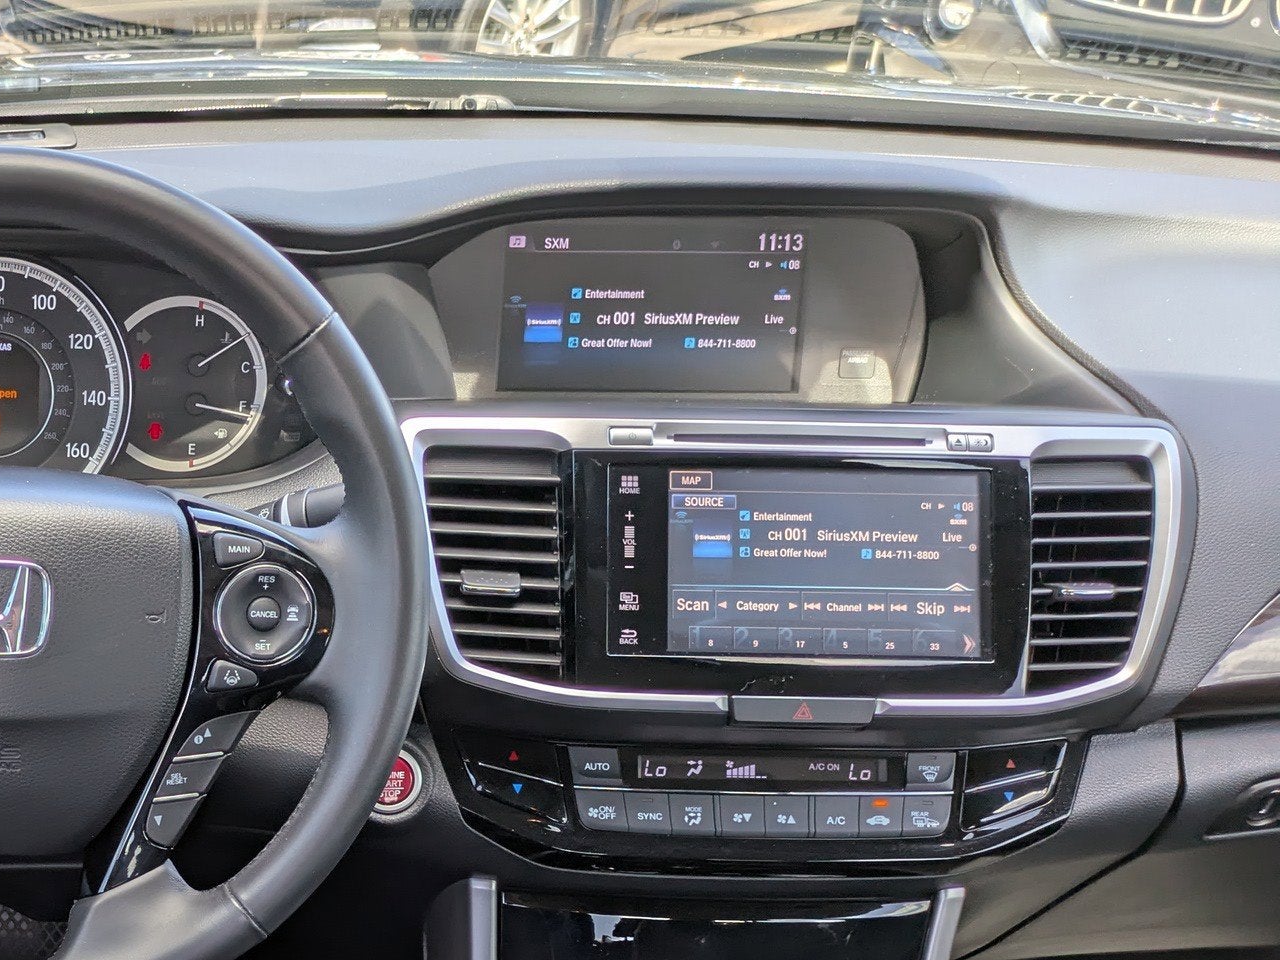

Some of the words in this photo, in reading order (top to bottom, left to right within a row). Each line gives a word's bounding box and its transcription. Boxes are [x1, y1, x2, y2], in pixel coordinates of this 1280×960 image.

[544, 238, 569, 249] SXM
[759, 233, 803, 251] 11:13
[789, 260, 800, 269] 08
[585, 289, 644, 299] Entertainment
[32, 295, 56, 310] 100
[196, 315, 204, 327] H
[597, 315, 610, 325] CH
[614, 312, 635, 325] 001
[645, 313, 692, 325] SiriusXM
[696, 313, 739, 325] Preview
[765, 314, 783, 324] Live
[69, 334, 93, 349] 120
[582, 338, 604, 348] Great
[607, 338, 628, 348] Offer
[630, 338, 652, 348] Now!
[698, 338, 756, 348] 844-711-8800
[242, 362, 249, 373] C
[83, 391, 106, 406] 140
[240, 401, 246, 412] F
[66, 443, 89, 458] 160
[189, 444, 195, 455] E
[682, 476, 701, 485] MAP
[685, 497, 724, 507] SOURCE
[962, 502, 974, 511] 08
[753, 512, 812, 521] Entertainment
[768, 531, 781, 540] CH
[785, 528, 807, 541] 001
[817, 530, 869, 541] SiriusXM
[873, 531, 918, 542] Preview
[943, 532, 962, 542] Live
[228, 545, 250, 554] MAIN
[754, 549, 777, 557] Great
[781, 549, 802, 557] Offer
[804, 549, 827, 558] Now!
[876, 551, 939, 559] 844-711-8800
[258, 575, 275, 584] RES
[677, 598, 709, 611] Scan
[736, 601, 779, 612] Category
[827, 603, 861, 611] Channel
[917, 603, 945, 616] Skip
[250, 610, 277, 619] CANCEL
[619, 637, 638, 645] BACK
[255, 643, 271, 651] SET
[645, 760, 667, 777] Lo
[849, 764, 870, 780] Lo
[166, 777, 187, 785] RESET
[638, 813, 662, 821] SYNC
[827, 816, 845, 825] A/C
